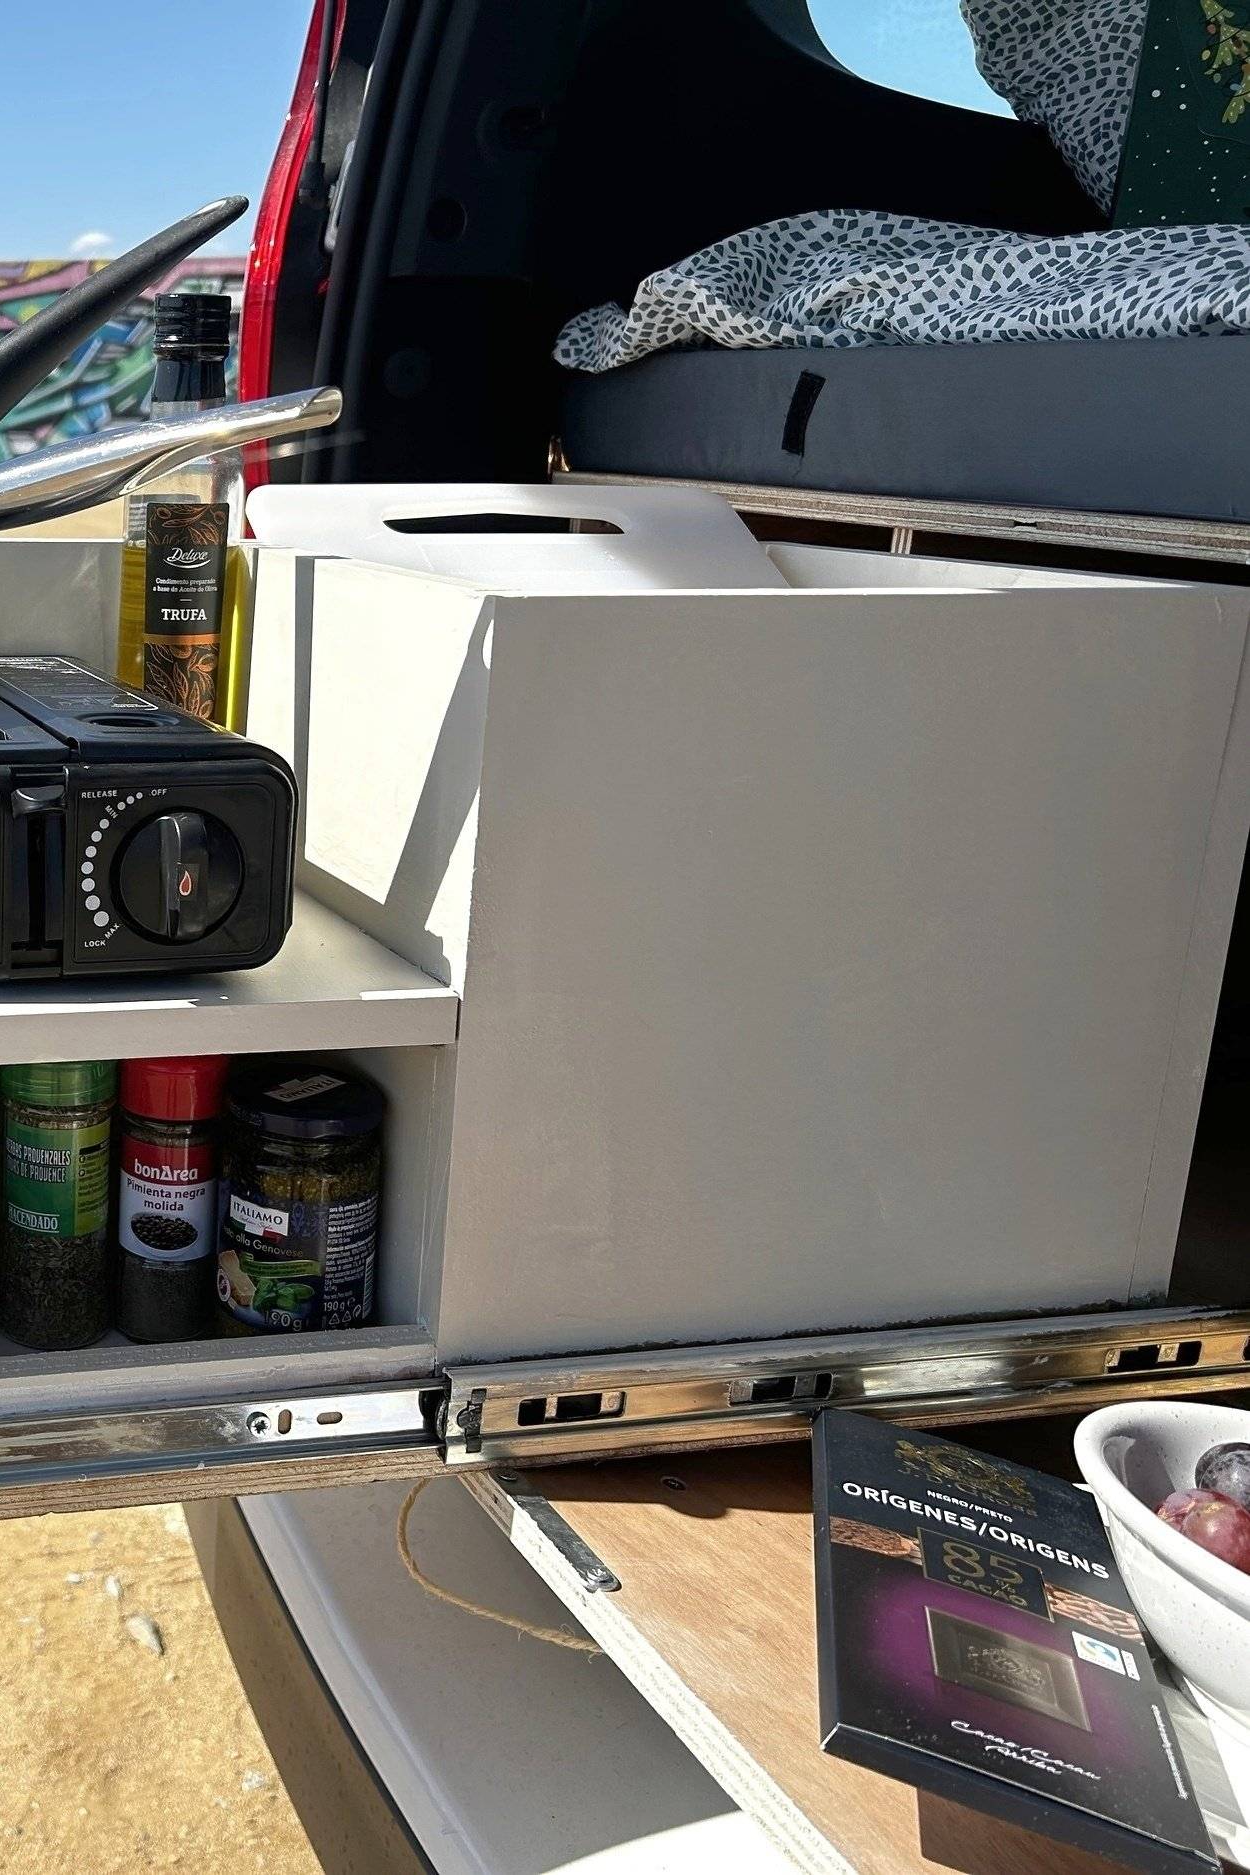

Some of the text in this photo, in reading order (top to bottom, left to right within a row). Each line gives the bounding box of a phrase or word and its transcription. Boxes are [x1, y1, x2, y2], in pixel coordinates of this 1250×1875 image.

[166, 547, 208, 563] Deluxe
[161, 608, 207, 621] TRUFA
[81, 789, 118, 799] RELEASE
[151, 788, 167, 797] OFF
[104, 804, 119, 820] MIN
[104, 923, 120, 939] MAX
[84, 940, 106, 948] LOCK
[23, 1145, 71, 1166] PROVENZALES
[29, 1165, 66, 1183] PROVENCE
[134, 1158, 199, 1181] bonArea
[126, 1177, 206, 1200] Pimienta negra
[143, 1200, 184, 1212] molida
[233, 1201, 283, 1225] ITALIAMO
[8, 1204, 59, 1231] HACENDADO
[236, 1233, 250, 1246] alla
[253, 1239, 303, 1258] Genovese
[324, 1300, 339, 1312] 190
[926, 1489, 1013, 1523] NEGRO/PRETO
[842, 1482, 1110, 1580] ORÍGENES/ORIGENS
[948, 1574, 1029, 1607] CACAO
